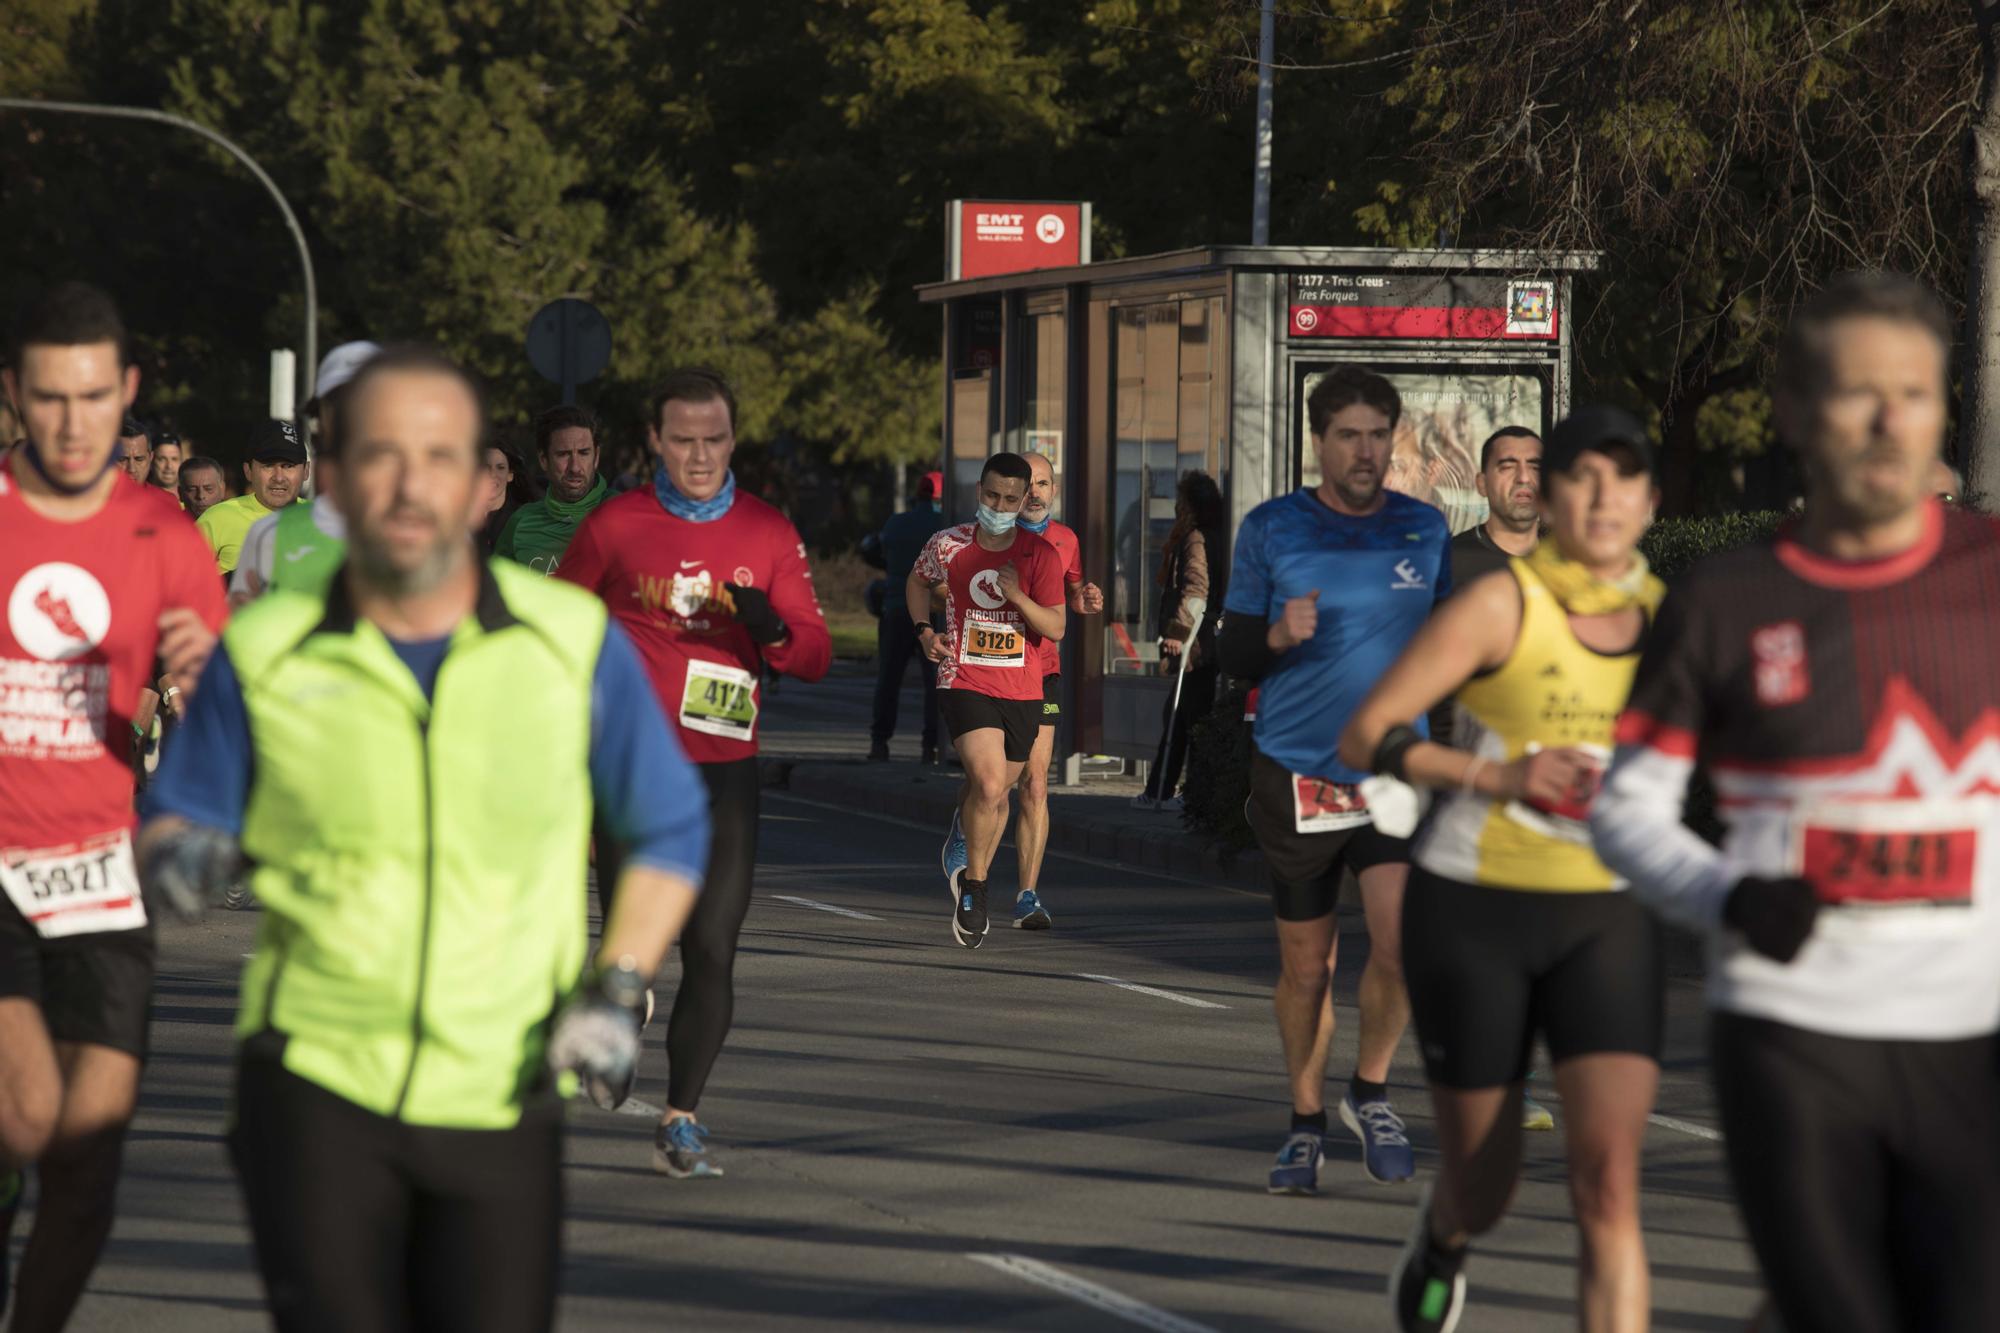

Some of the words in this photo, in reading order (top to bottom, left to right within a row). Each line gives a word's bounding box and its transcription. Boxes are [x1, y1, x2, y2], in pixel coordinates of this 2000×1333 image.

[976, 213, 1024, 226] EMT
[1298, 274, 1324, 287] 1177
[1331, 275, 1354, 287] Tres
[1355, 275, 1384, 287] Creus
[1298, 288, 1318, 301] Tres
[1319, 288, 1359, 304] Forques
[1300, 313, 1314, 326] 99
[965, 608, 1006, 622] CIRCUIT
[1007, 610, 1020, 622] DE
[976, 630, 1016, 650] 3126
